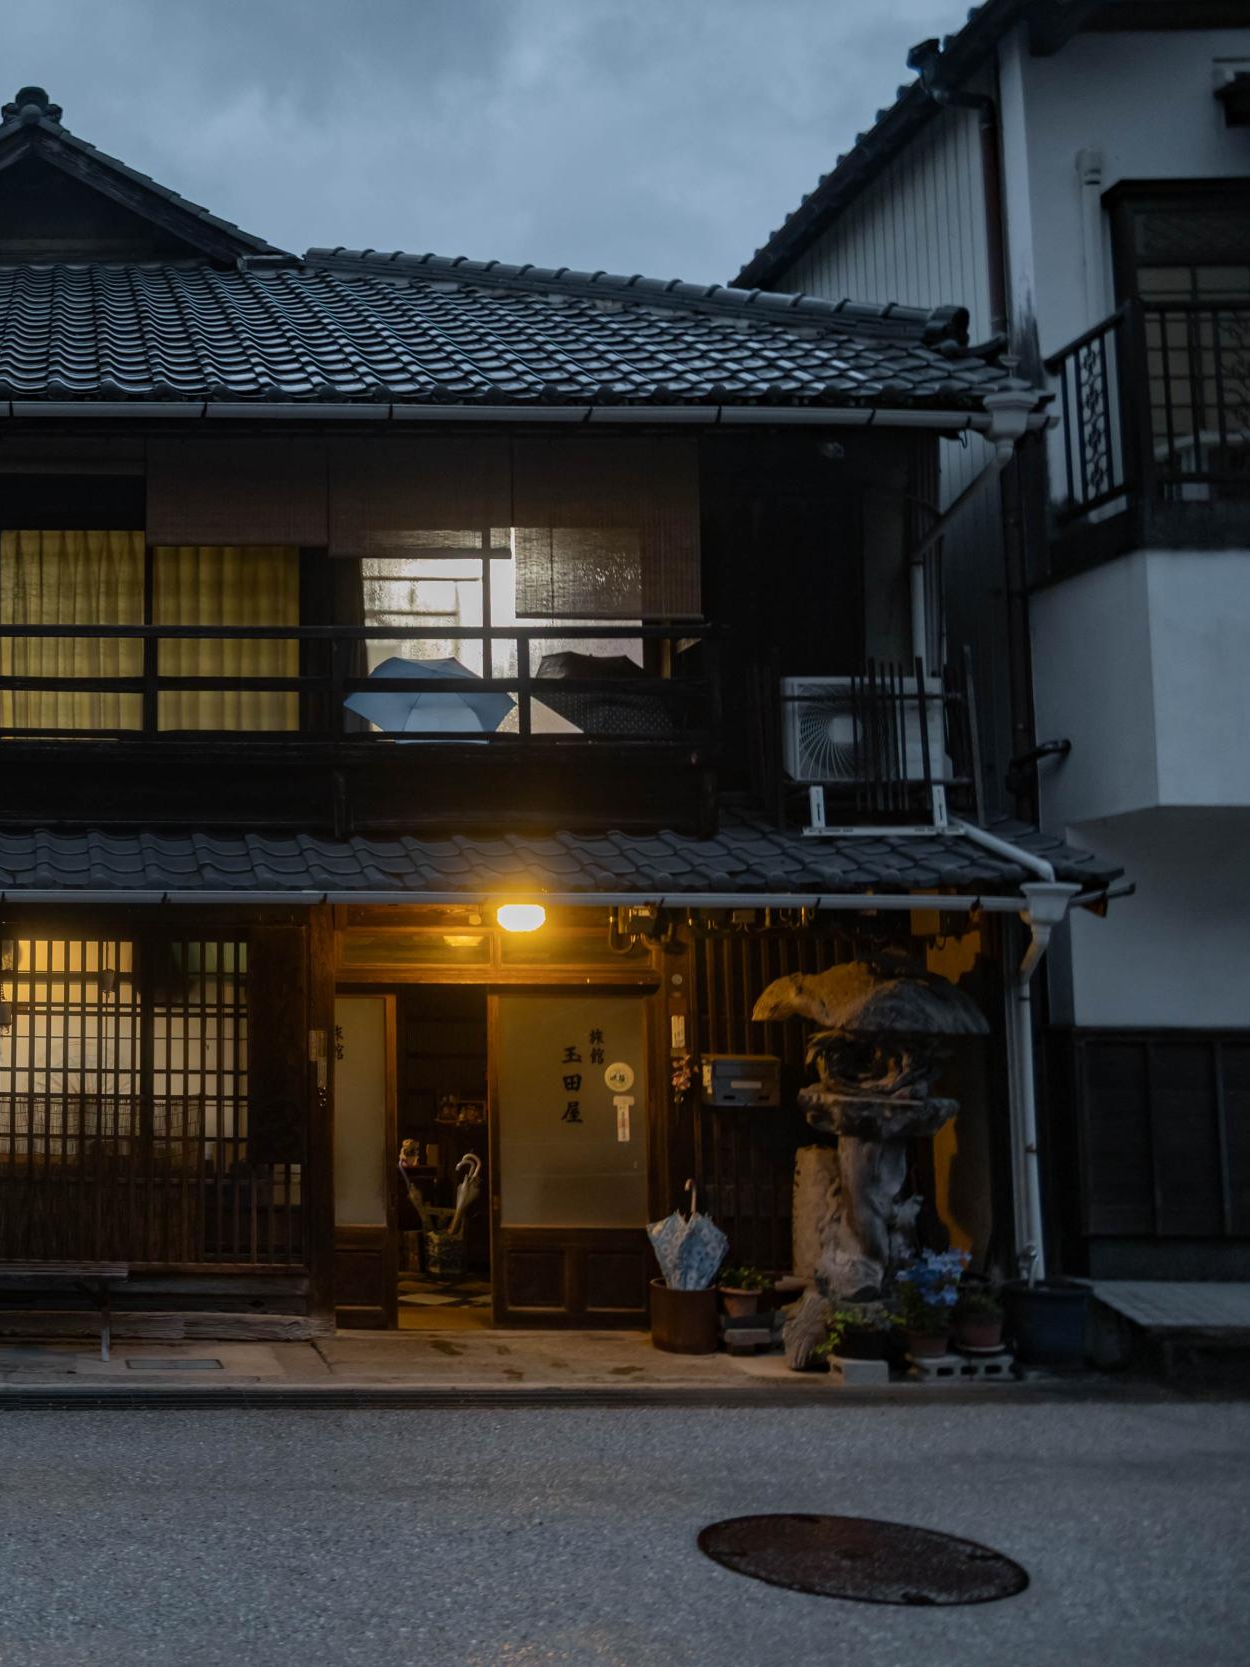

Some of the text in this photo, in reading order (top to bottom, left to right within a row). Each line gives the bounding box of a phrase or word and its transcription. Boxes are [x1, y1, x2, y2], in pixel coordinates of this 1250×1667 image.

[589, 1028, 605, 1065] 旅館
[561, 1046, 583, 1124] 玉田屋
